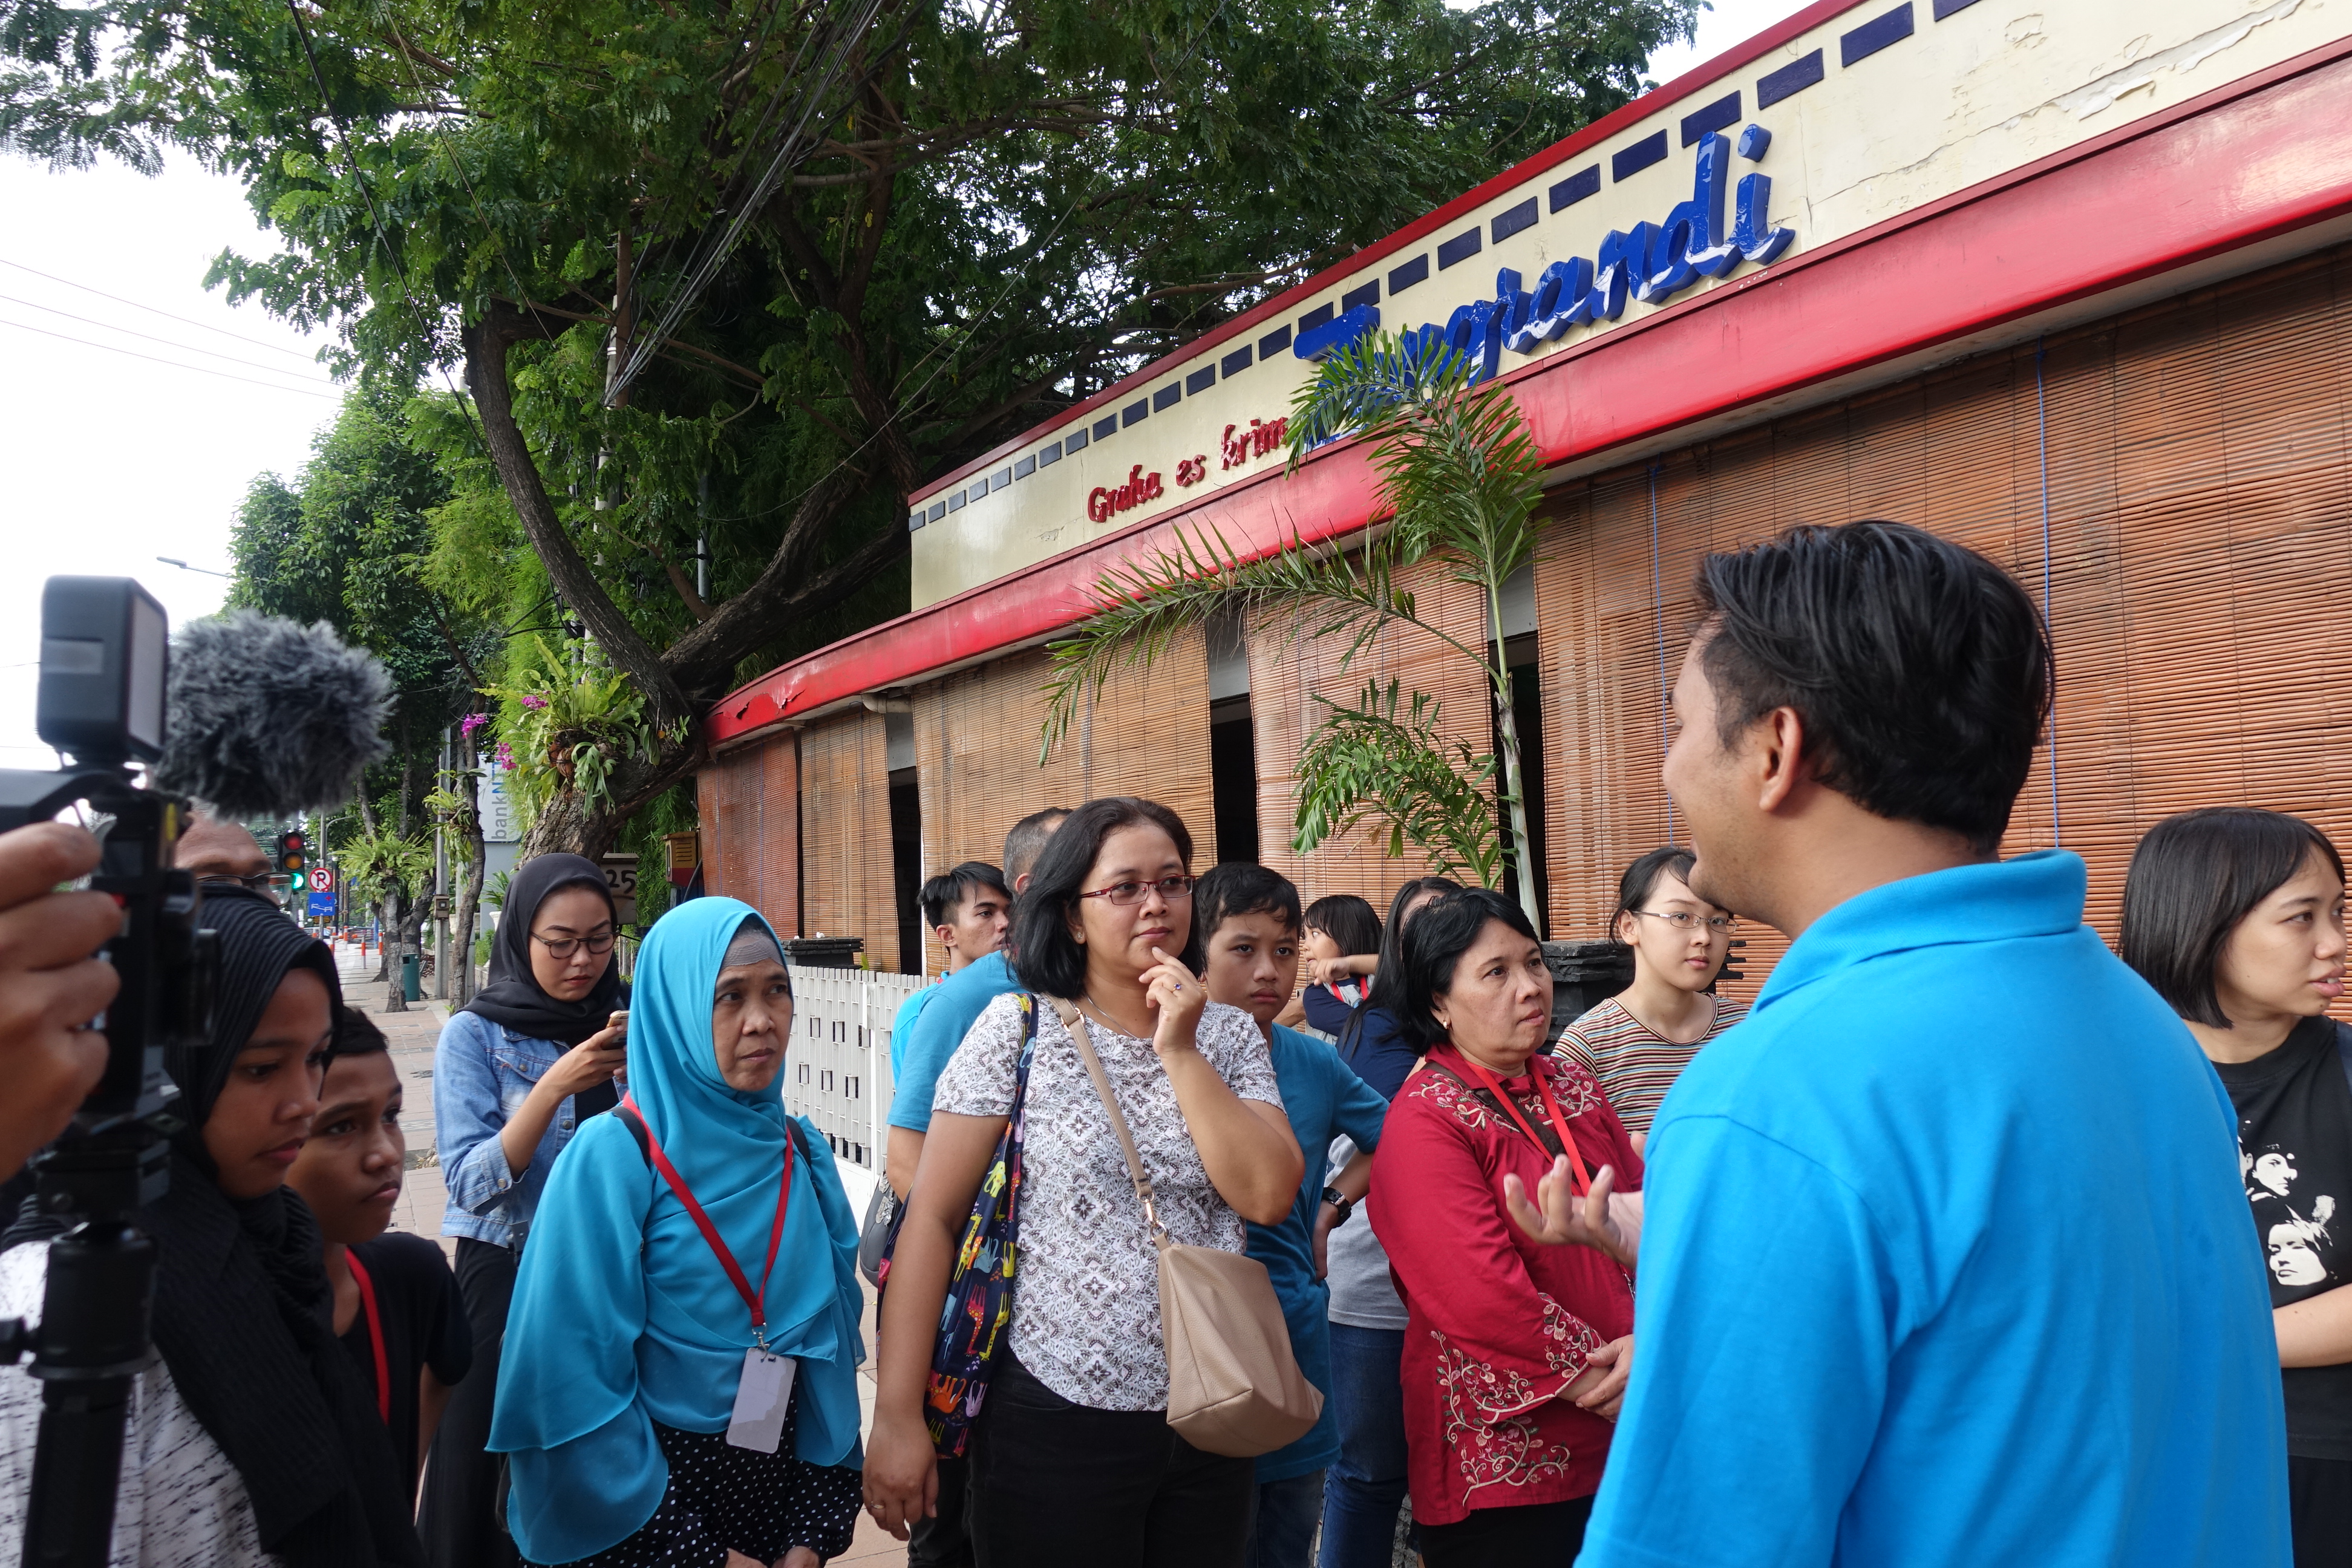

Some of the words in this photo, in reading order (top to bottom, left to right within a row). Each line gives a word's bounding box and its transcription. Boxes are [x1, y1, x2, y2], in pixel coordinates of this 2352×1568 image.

[1088, 465, 1164, 523] Graha
[1176, 454, 1206, 487] es
[1220, 417, 1289, 470] krim
[316, 872, 326, 887] P
